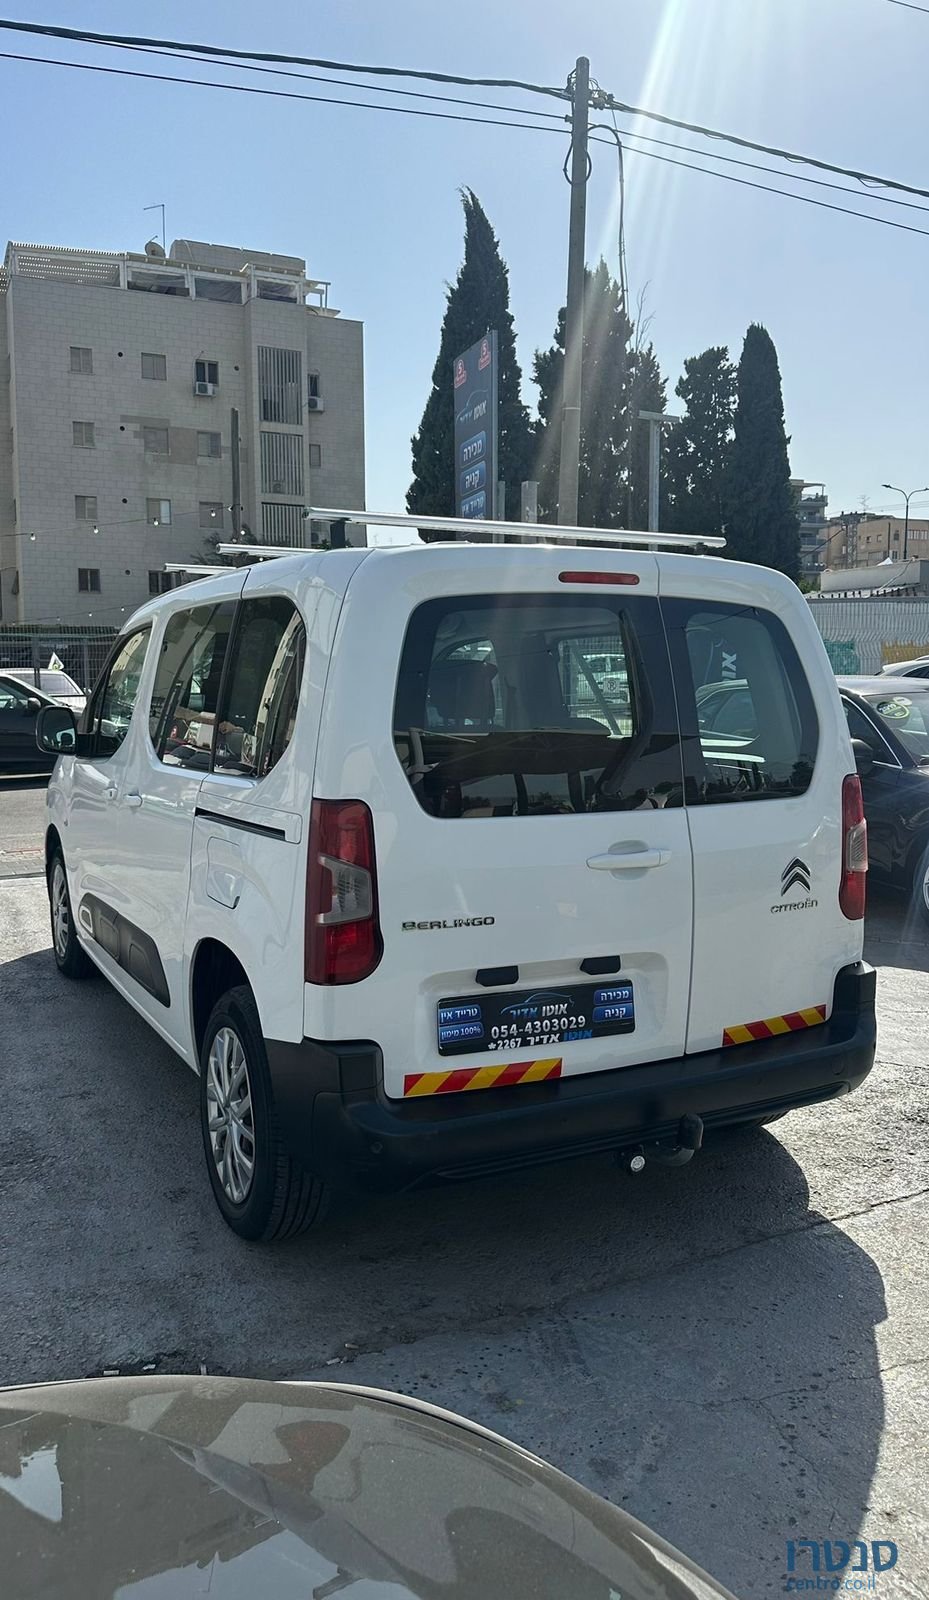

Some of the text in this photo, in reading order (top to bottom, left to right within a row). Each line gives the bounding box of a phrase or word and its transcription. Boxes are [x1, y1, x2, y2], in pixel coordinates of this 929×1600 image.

[463, 439, 482, 461] מכירה
[465, 470, 480, 488] קניה
[402, 916, 495, 931] BERLINGO
[600, 990, 629, 1001] מכירה
[440, 1008, 478, 1023] טרייד אין
[509, 1003, 568, 1019] אוטו אדיר
[604, 1007, 626, 1018] קניה
[441, 1025, 481, 1040] 100% מימון
[491, 1015, 586, 1039] 054-4303029
[526, 1033, 560, 1046] אדיר
[563, 1029, 593, 1041] אוטו
